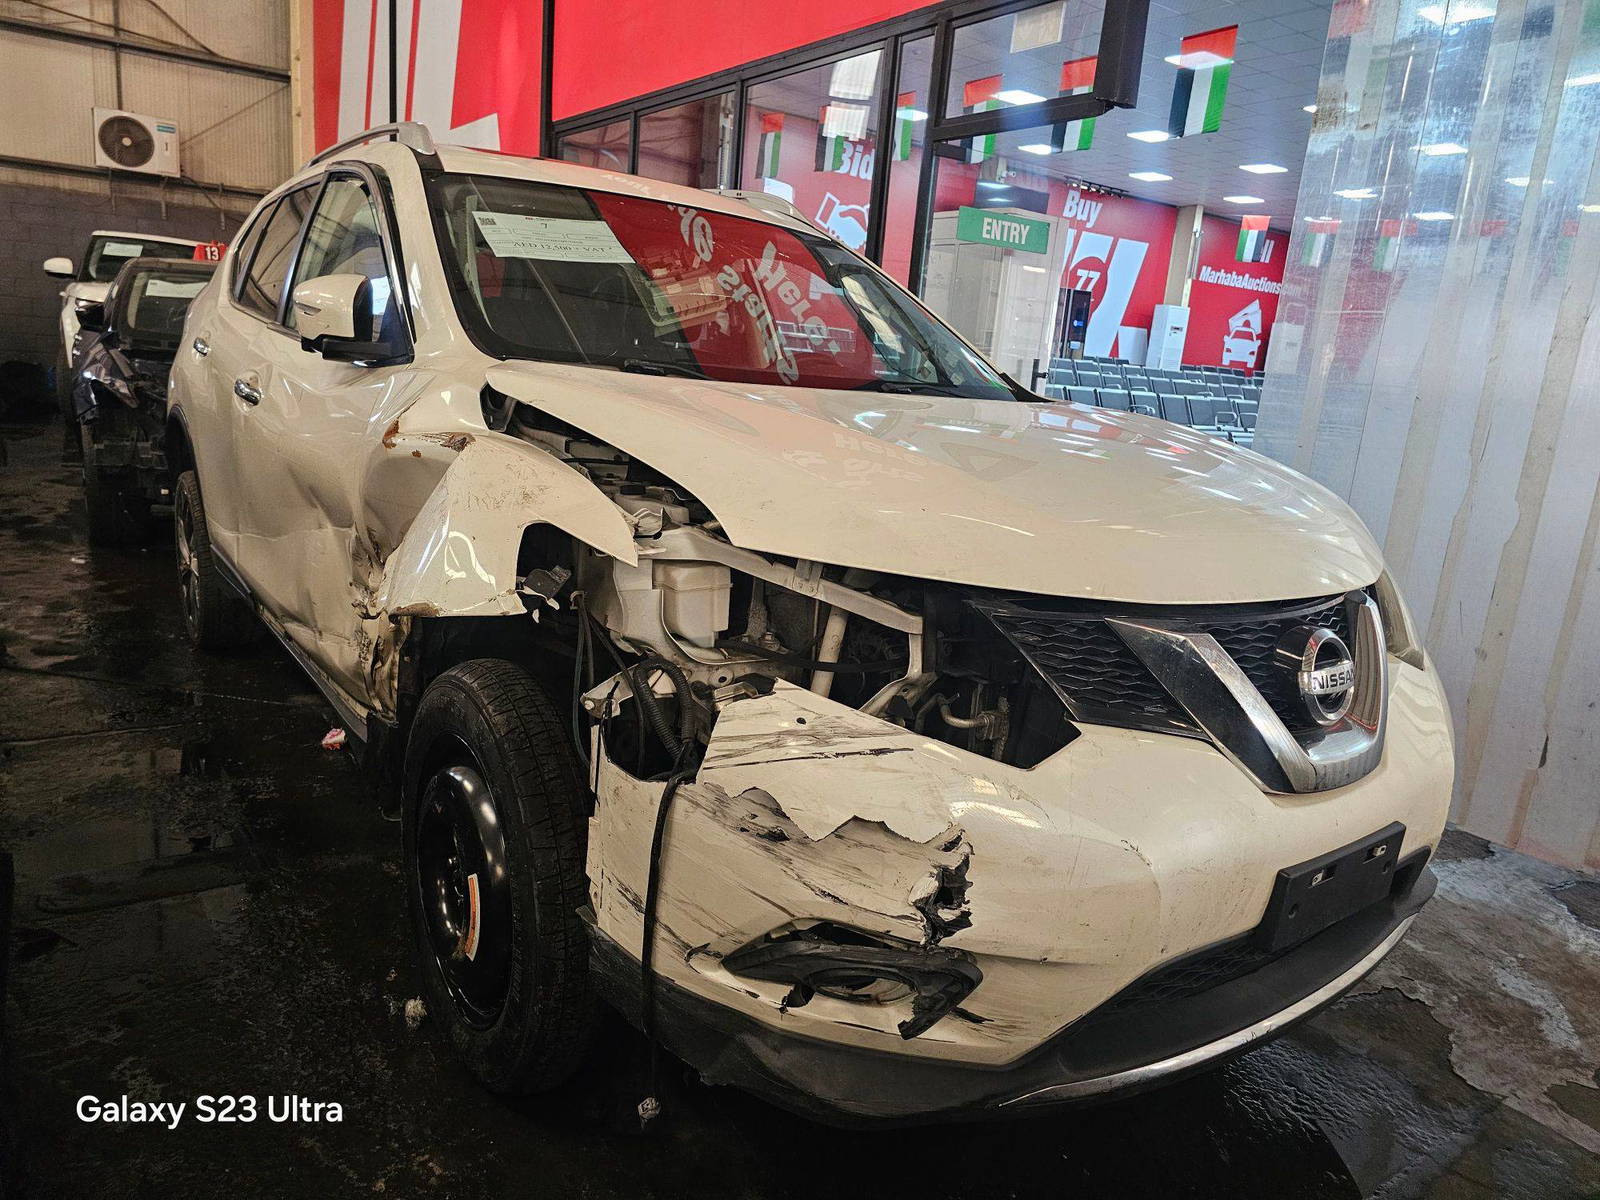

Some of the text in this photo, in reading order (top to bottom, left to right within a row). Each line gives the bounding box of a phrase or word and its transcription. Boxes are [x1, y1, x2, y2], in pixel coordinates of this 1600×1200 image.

[1063, 189, 1103, 228] Buy
[982, 217, 1030, 245] ENTRY
[206, 246, 219, 261] 13
[1075, 269, 1101, 291] 77
